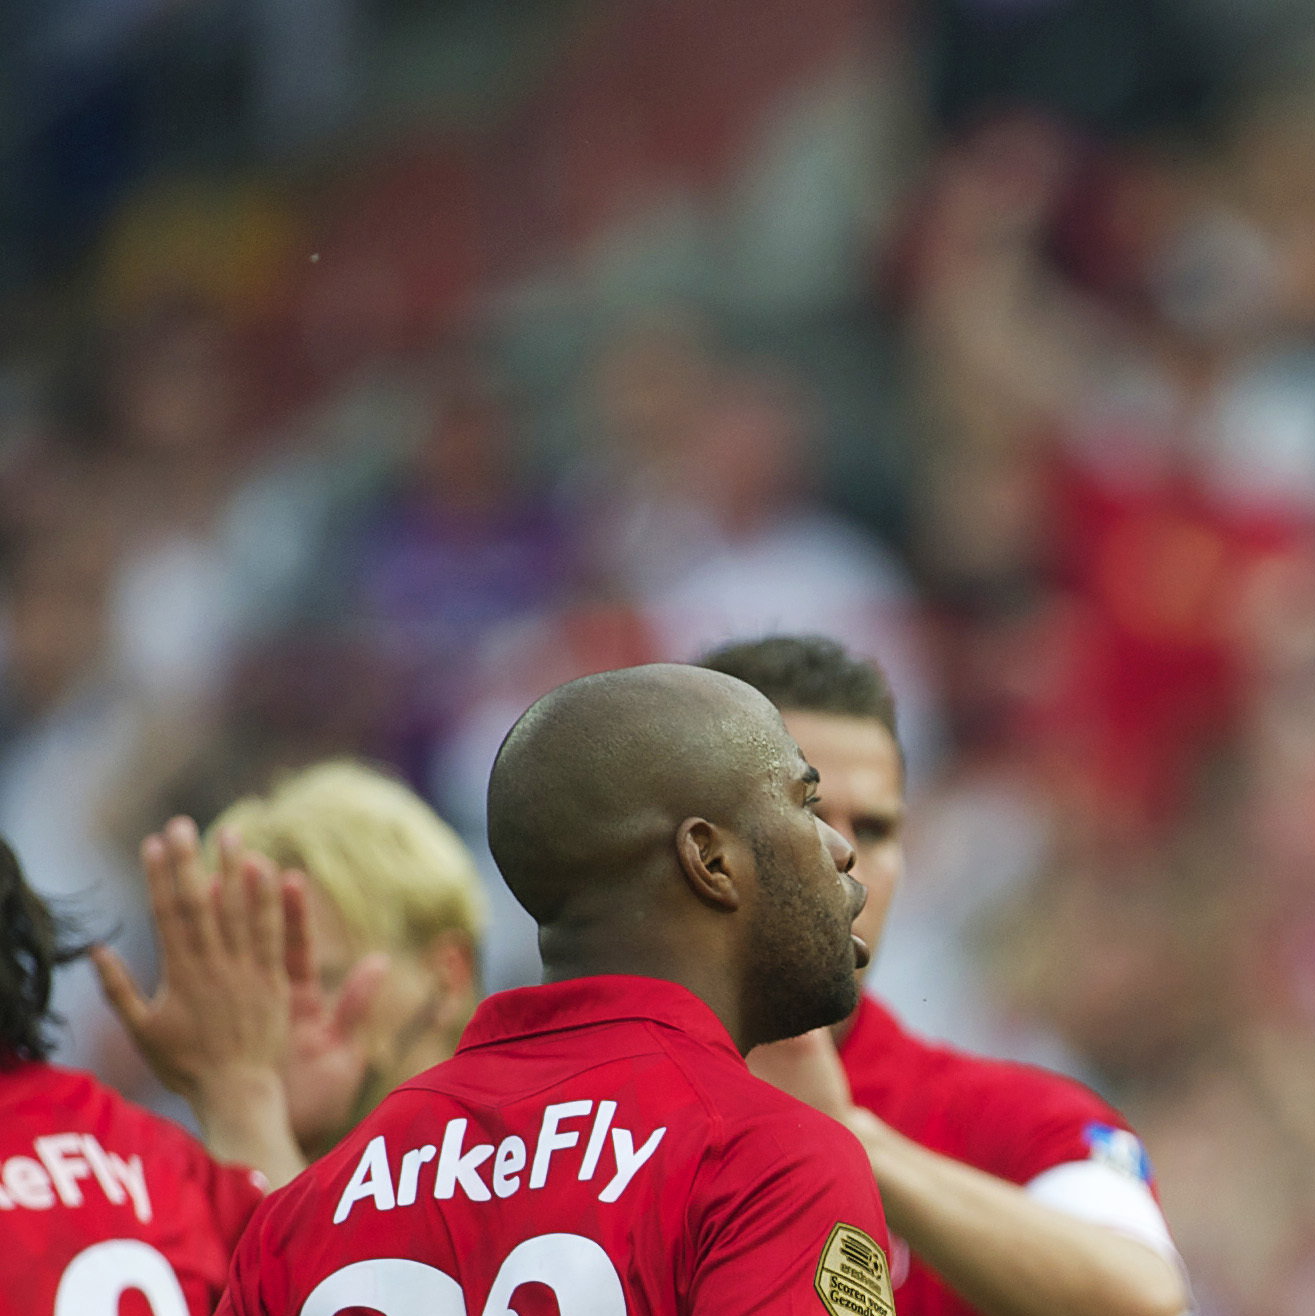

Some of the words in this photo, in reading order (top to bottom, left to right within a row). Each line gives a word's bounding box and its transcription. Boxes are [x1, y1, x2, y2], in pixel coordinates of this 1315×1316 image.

[0, 1131, 153, 1224] eFly
[333, 1099, 667, 1225] ArkeFly
[830, 1275, 867, 1305] Scoren
